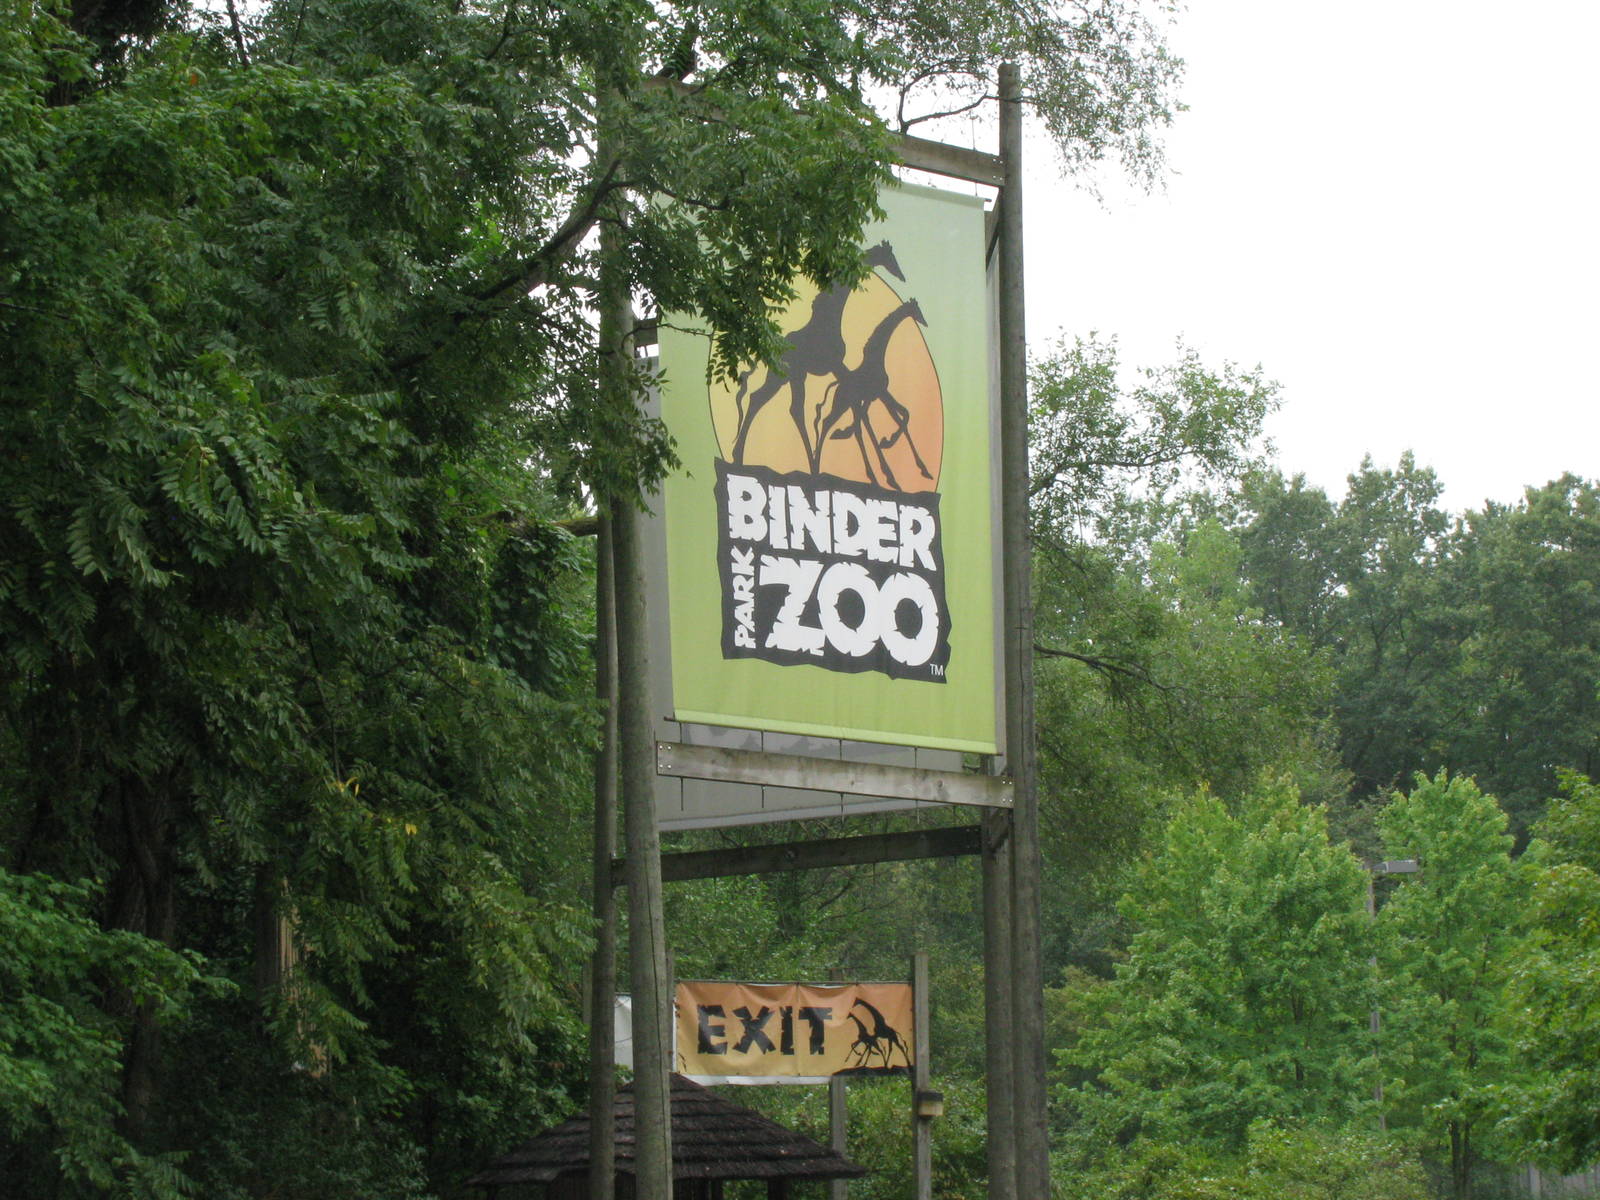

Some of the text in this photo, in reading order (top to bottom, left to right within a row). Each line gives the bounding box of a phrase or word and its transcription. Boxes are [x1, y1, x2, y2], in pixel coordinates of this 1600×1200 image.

[727, 474, 936, 571] BINDER
[730, 545, 757, 649] PARK
[759, 554, 939, 667] ZOO
[697, 1004, 833, 1055] EXIT
